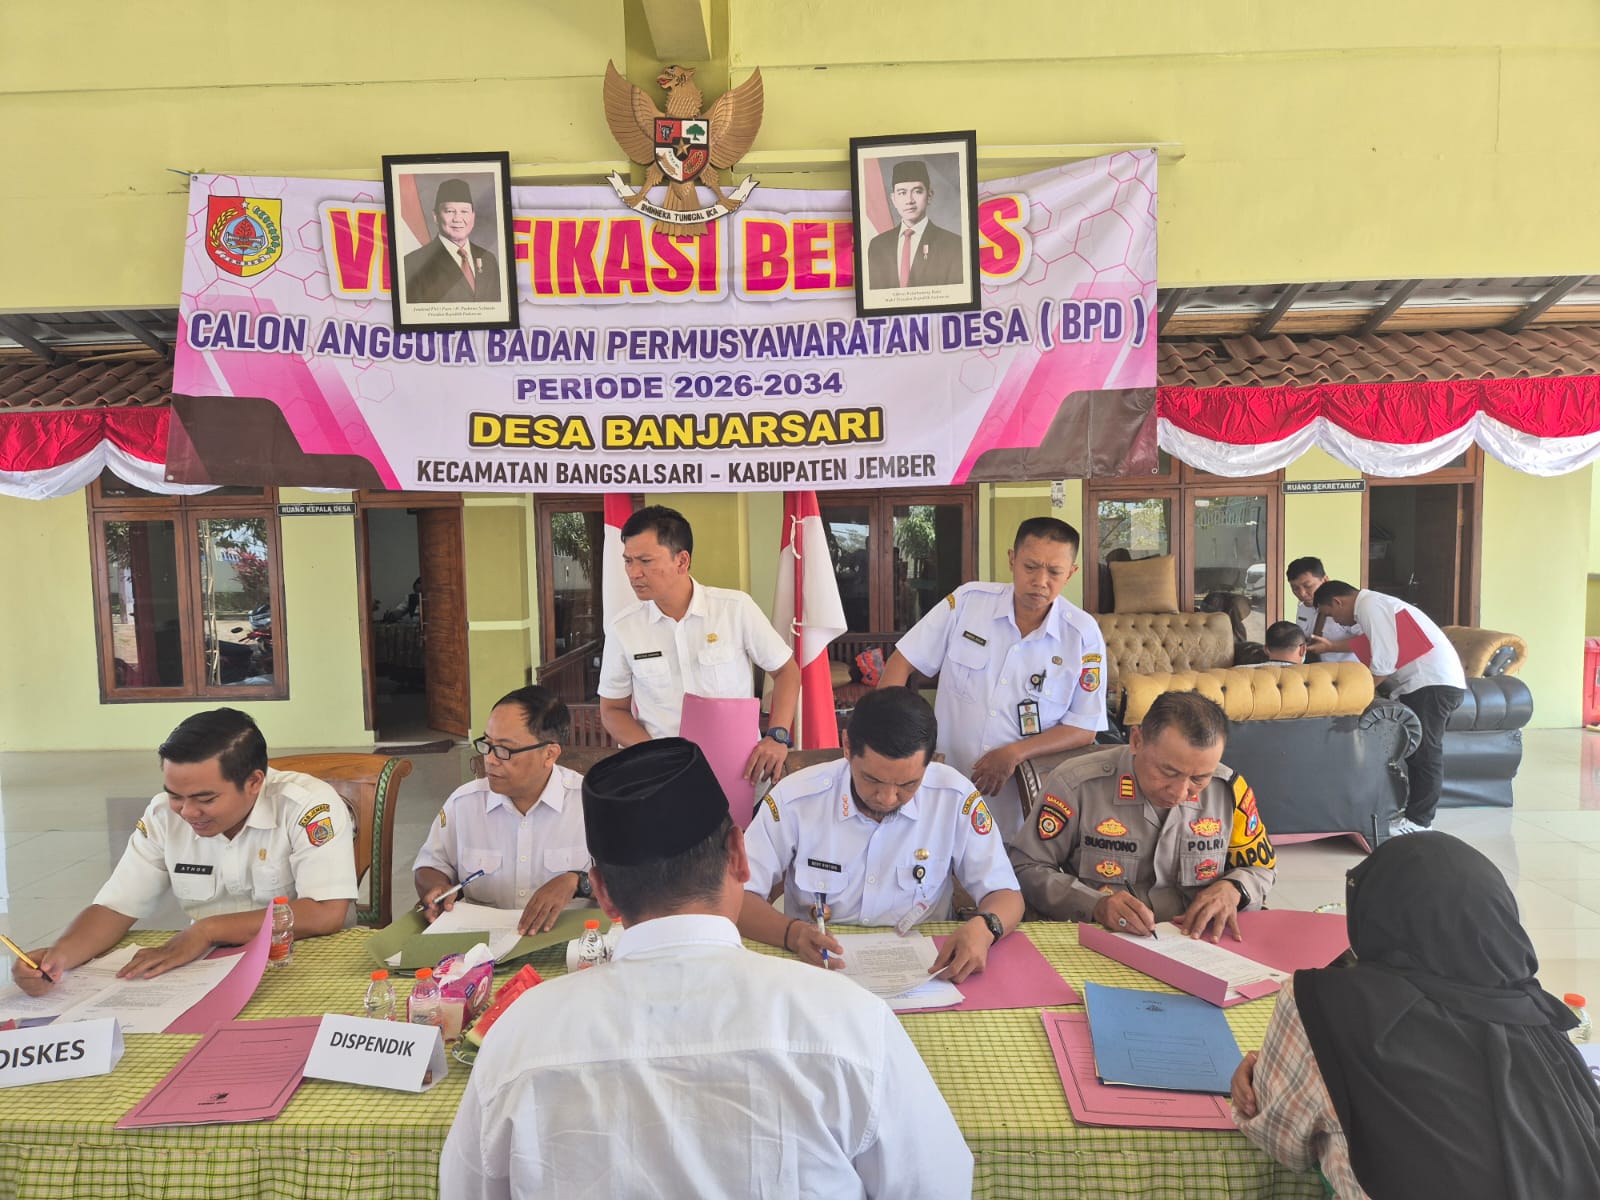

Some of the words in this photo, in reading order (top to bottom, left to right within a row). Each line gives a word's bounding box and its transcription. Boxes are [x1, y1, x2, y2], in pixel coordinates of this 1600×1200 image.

[744, 197, 1022, 292] BES
[191, 312, 306, 353] CALON
[316, 321, 476, 363] ANGGOTA
[487, 328, 595, 362] BADAN
[606, 316, 931, 361] PERMUSYAWARATAN
[941, 308, 1029, 350] DESA
[517, 377, 663, 400] PERIODE
[674, 372, 843, 398] 2026-2034
[471, 413, 594, 448] DESA
[603, 408, 882, 448] BANJARSARI
[417, 459, 548, 483] KECAMATAN
[556, 462, 703, 485] BANGSALSARI
[728, 458, 847, 484] KABUPATEN
[854, 453, 936, 480] JEMBER
[1287, 483, 1311, 491] RUANG
[1312, 482, 1361, 490] SEKRETARIAT
[306, 505, 332, 513] KEPALA
[1084, 836, 1138, 853] SUGIYONO
[1188, 838, 1224, 852] POLRI
[329, 1031, 416, 1057] DISPENDIK
